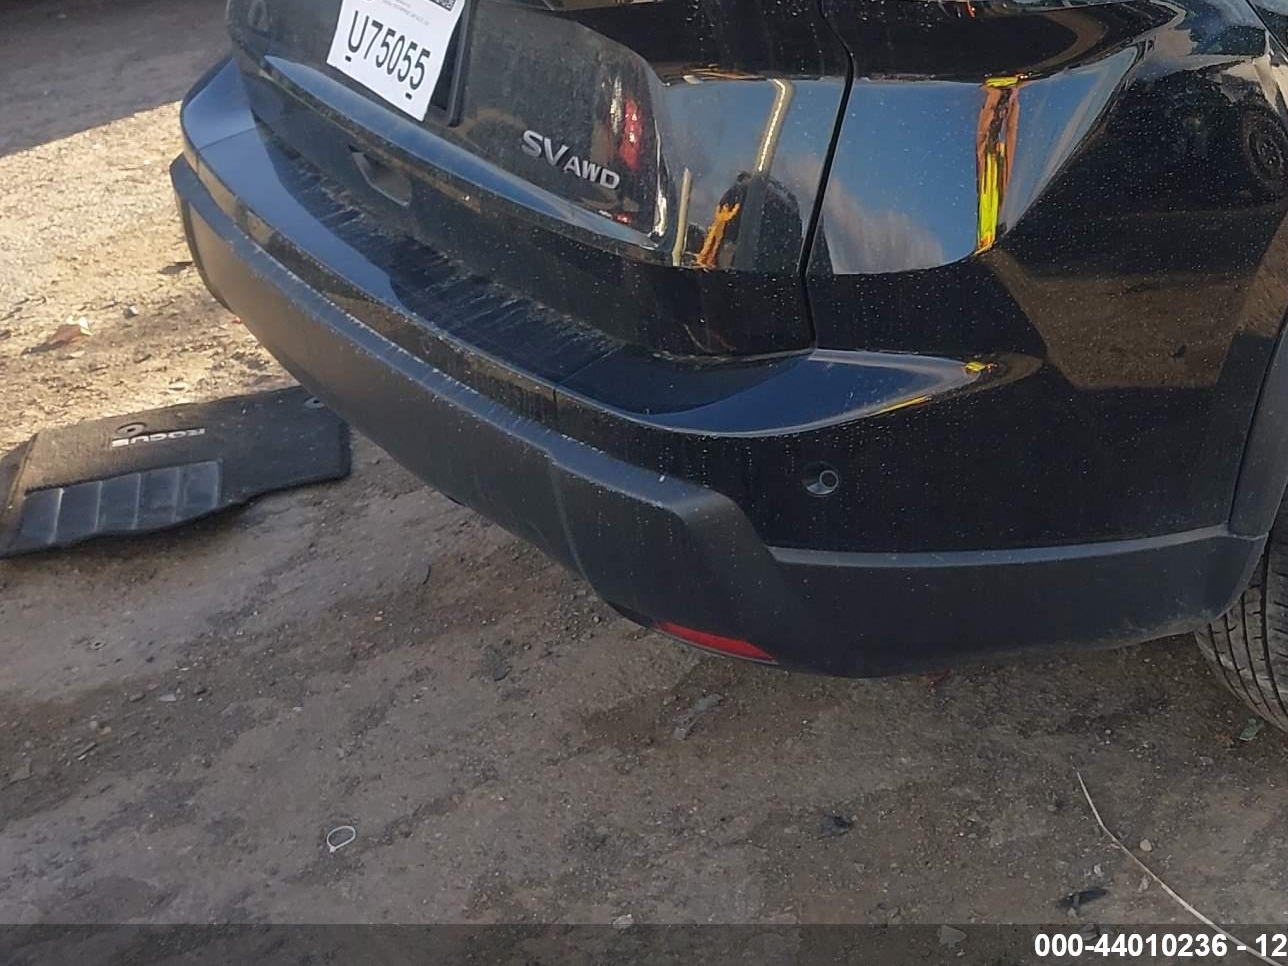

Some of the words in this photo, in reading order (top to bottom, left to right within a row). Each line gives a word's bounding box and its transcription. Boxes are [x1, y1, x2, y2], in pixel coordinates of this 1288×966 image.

[347, 9, 431, 91] U75055
[521, 129, 569, 166] SV
[563, 155, 620, 189] AWD
